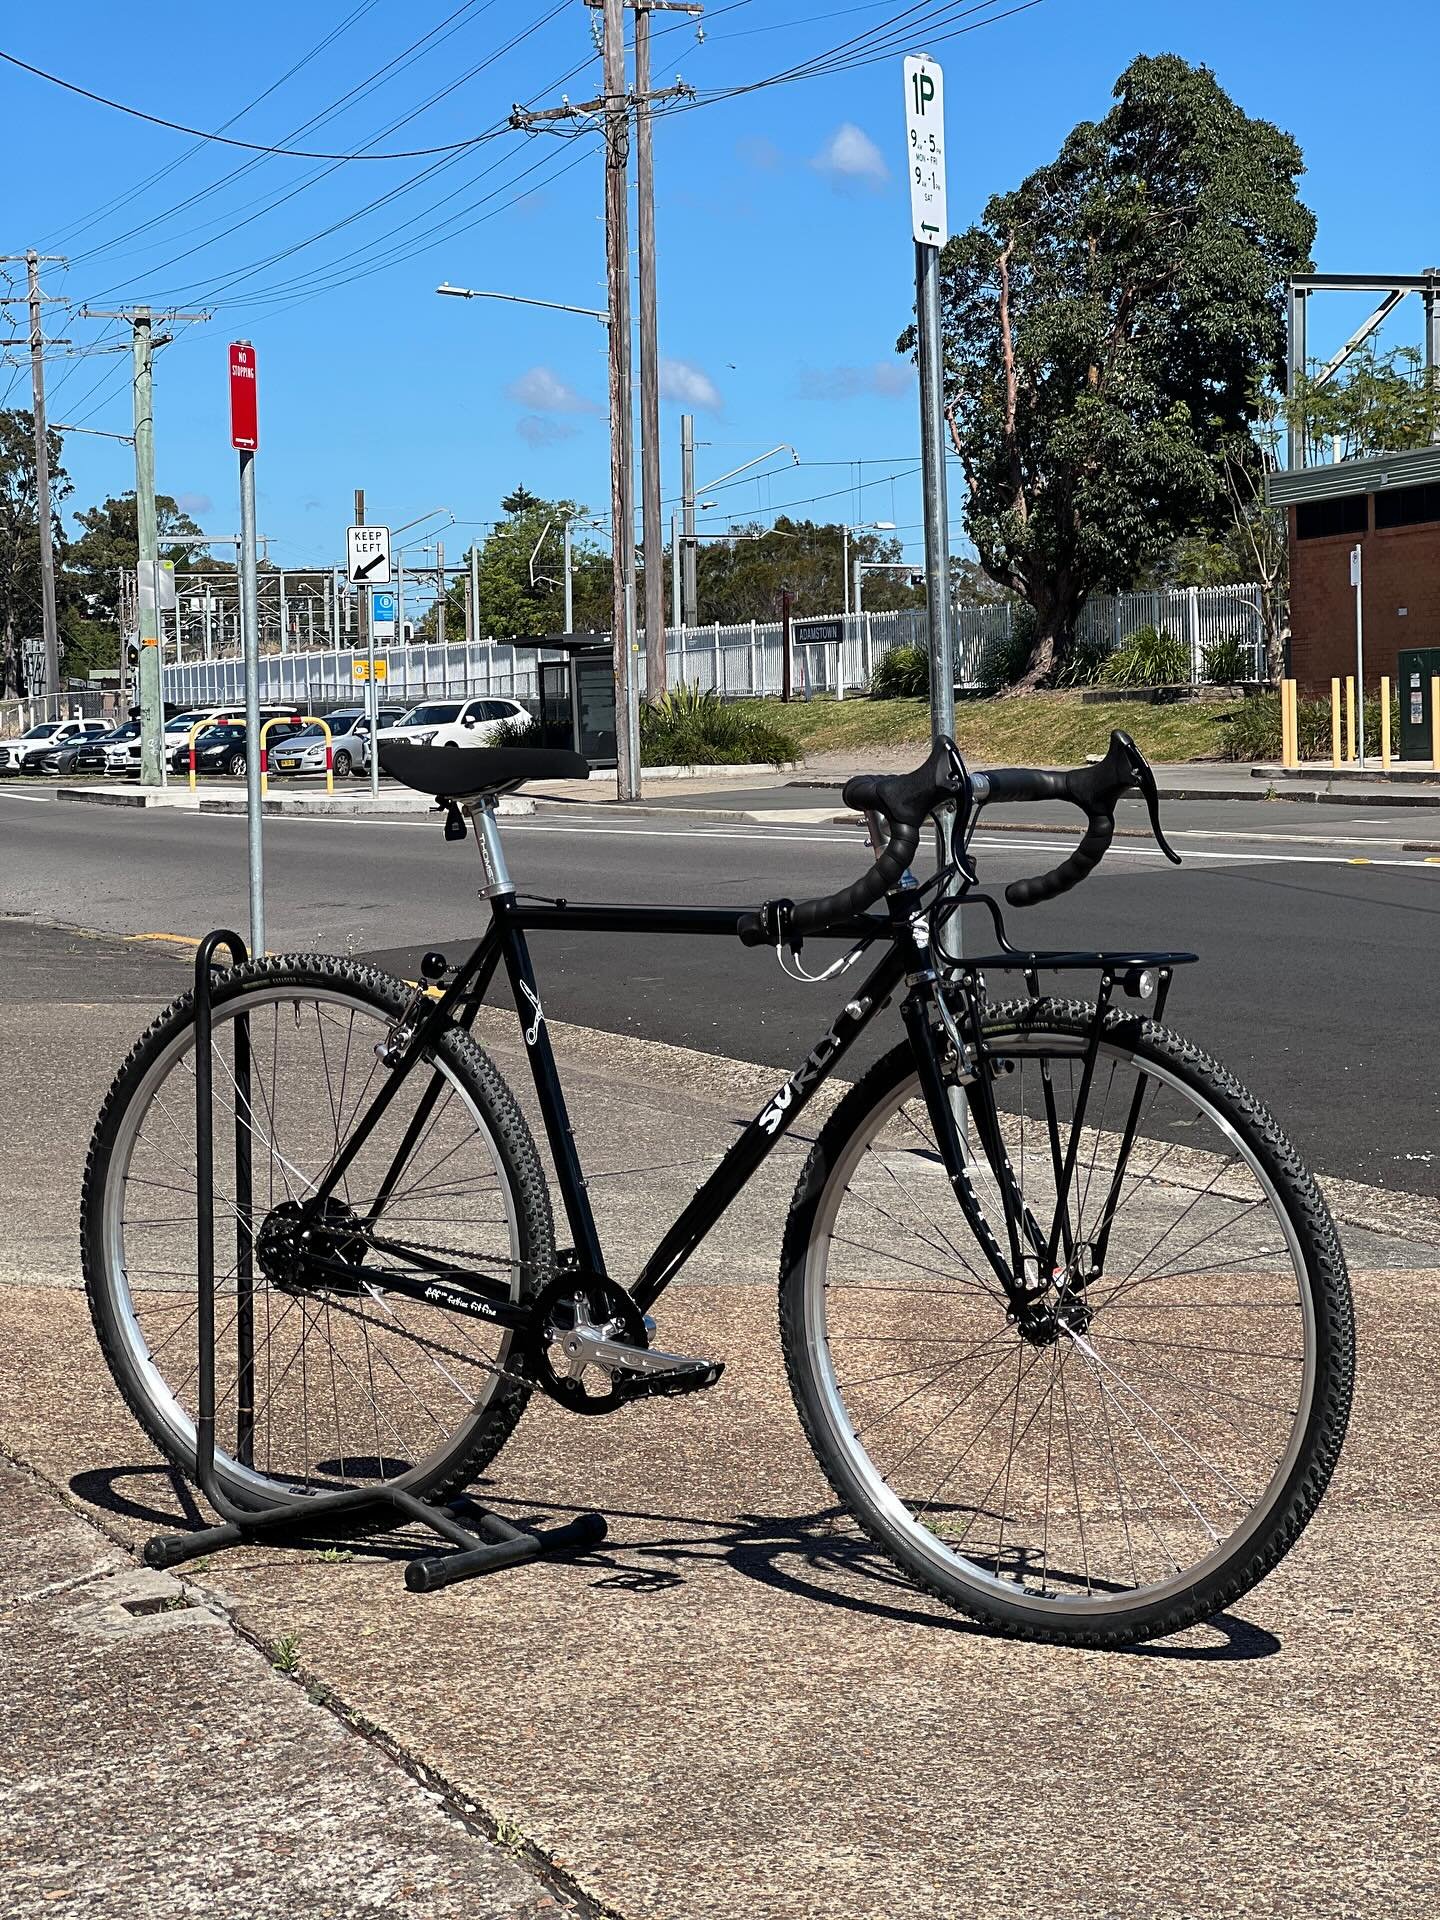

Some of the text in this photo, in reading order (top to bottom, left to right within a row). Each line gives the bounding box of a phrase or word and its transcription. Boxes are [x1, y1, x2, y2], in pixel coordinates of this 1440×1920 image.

[912, 72, 935, 116] 1P
[916, 153, 926, 162] MON
[930, 155, 938, 165] FRI
[924, 193, 933, 202] SAT
[239, 352, 247, 363] NO
[232, 365, 254, 378] STOPPING
[354, 531, 382, 541] KEEP
[356, 543, 381, 553] LEFT
[799, 626, 837, 640] ADAMSTOWN
